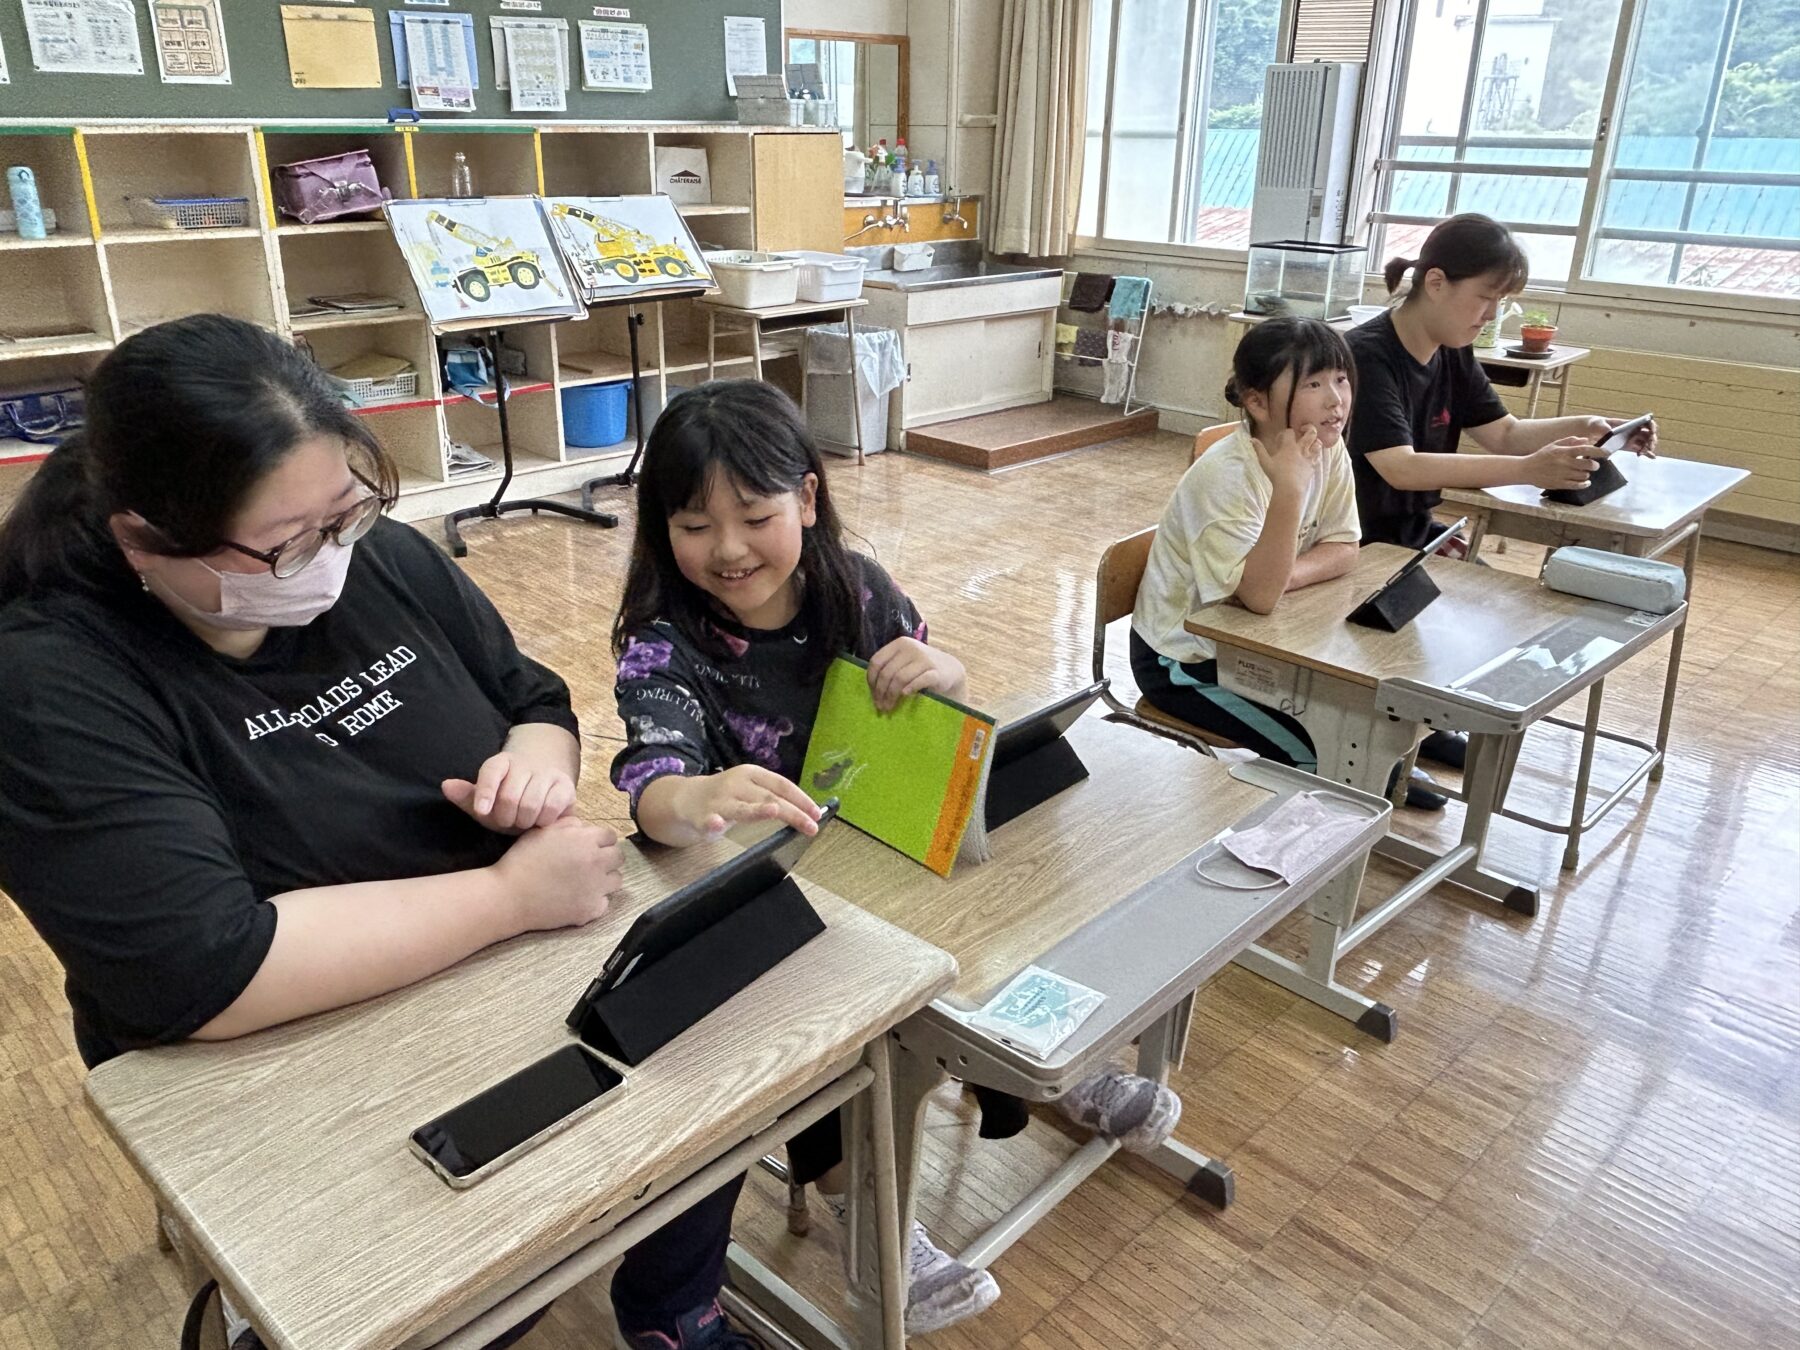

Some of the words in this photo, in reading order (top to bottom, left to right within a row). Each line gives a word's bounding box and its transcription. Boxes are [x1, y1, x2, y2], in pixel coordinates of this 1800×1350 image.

[244, 708, 299, 740] ALL
[359, 645, 417, 686] LEAD
[337, 689, 404, 737] ROME
